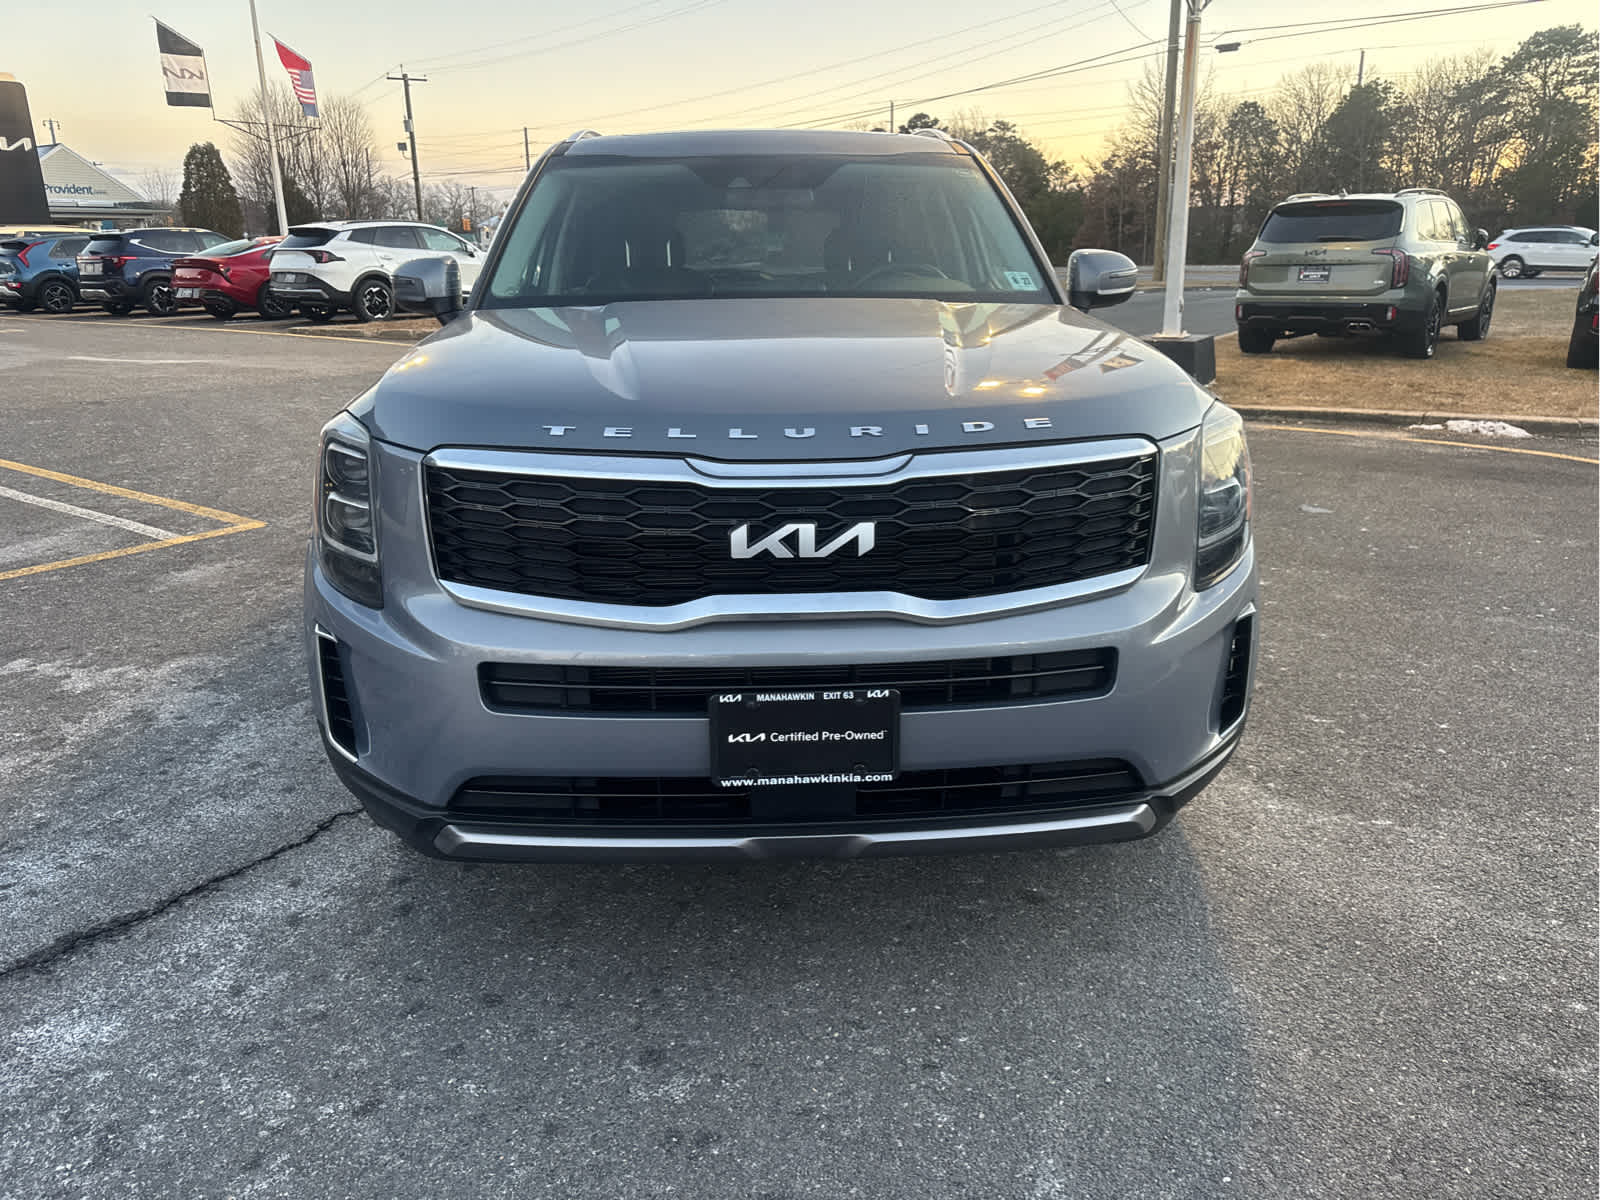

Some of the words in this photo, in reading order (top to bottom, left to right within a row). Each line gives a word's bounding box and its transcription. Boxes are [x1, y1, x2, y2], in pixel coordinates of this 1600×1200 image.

[43, 184, 93, 195] Provident
[542, 417, 1052, 439] TELLURIDE
[730, 521, 876, 559] KIA
[719, 694, 742, 703] KIA
[756, 692, 815, 702] MANAHAWKIN
[823, 692, 841, 700] EXIT
[842, 691, 854, 699] 63
[867, 689, 889, 698] KIA
[728, 733, 766, 743] KIA
[770, 732, 819, 742] Certified
[822, 730, 885, 741] Pre-Owned
[720, 773, 893, 787] www.manahawkinkia.com
